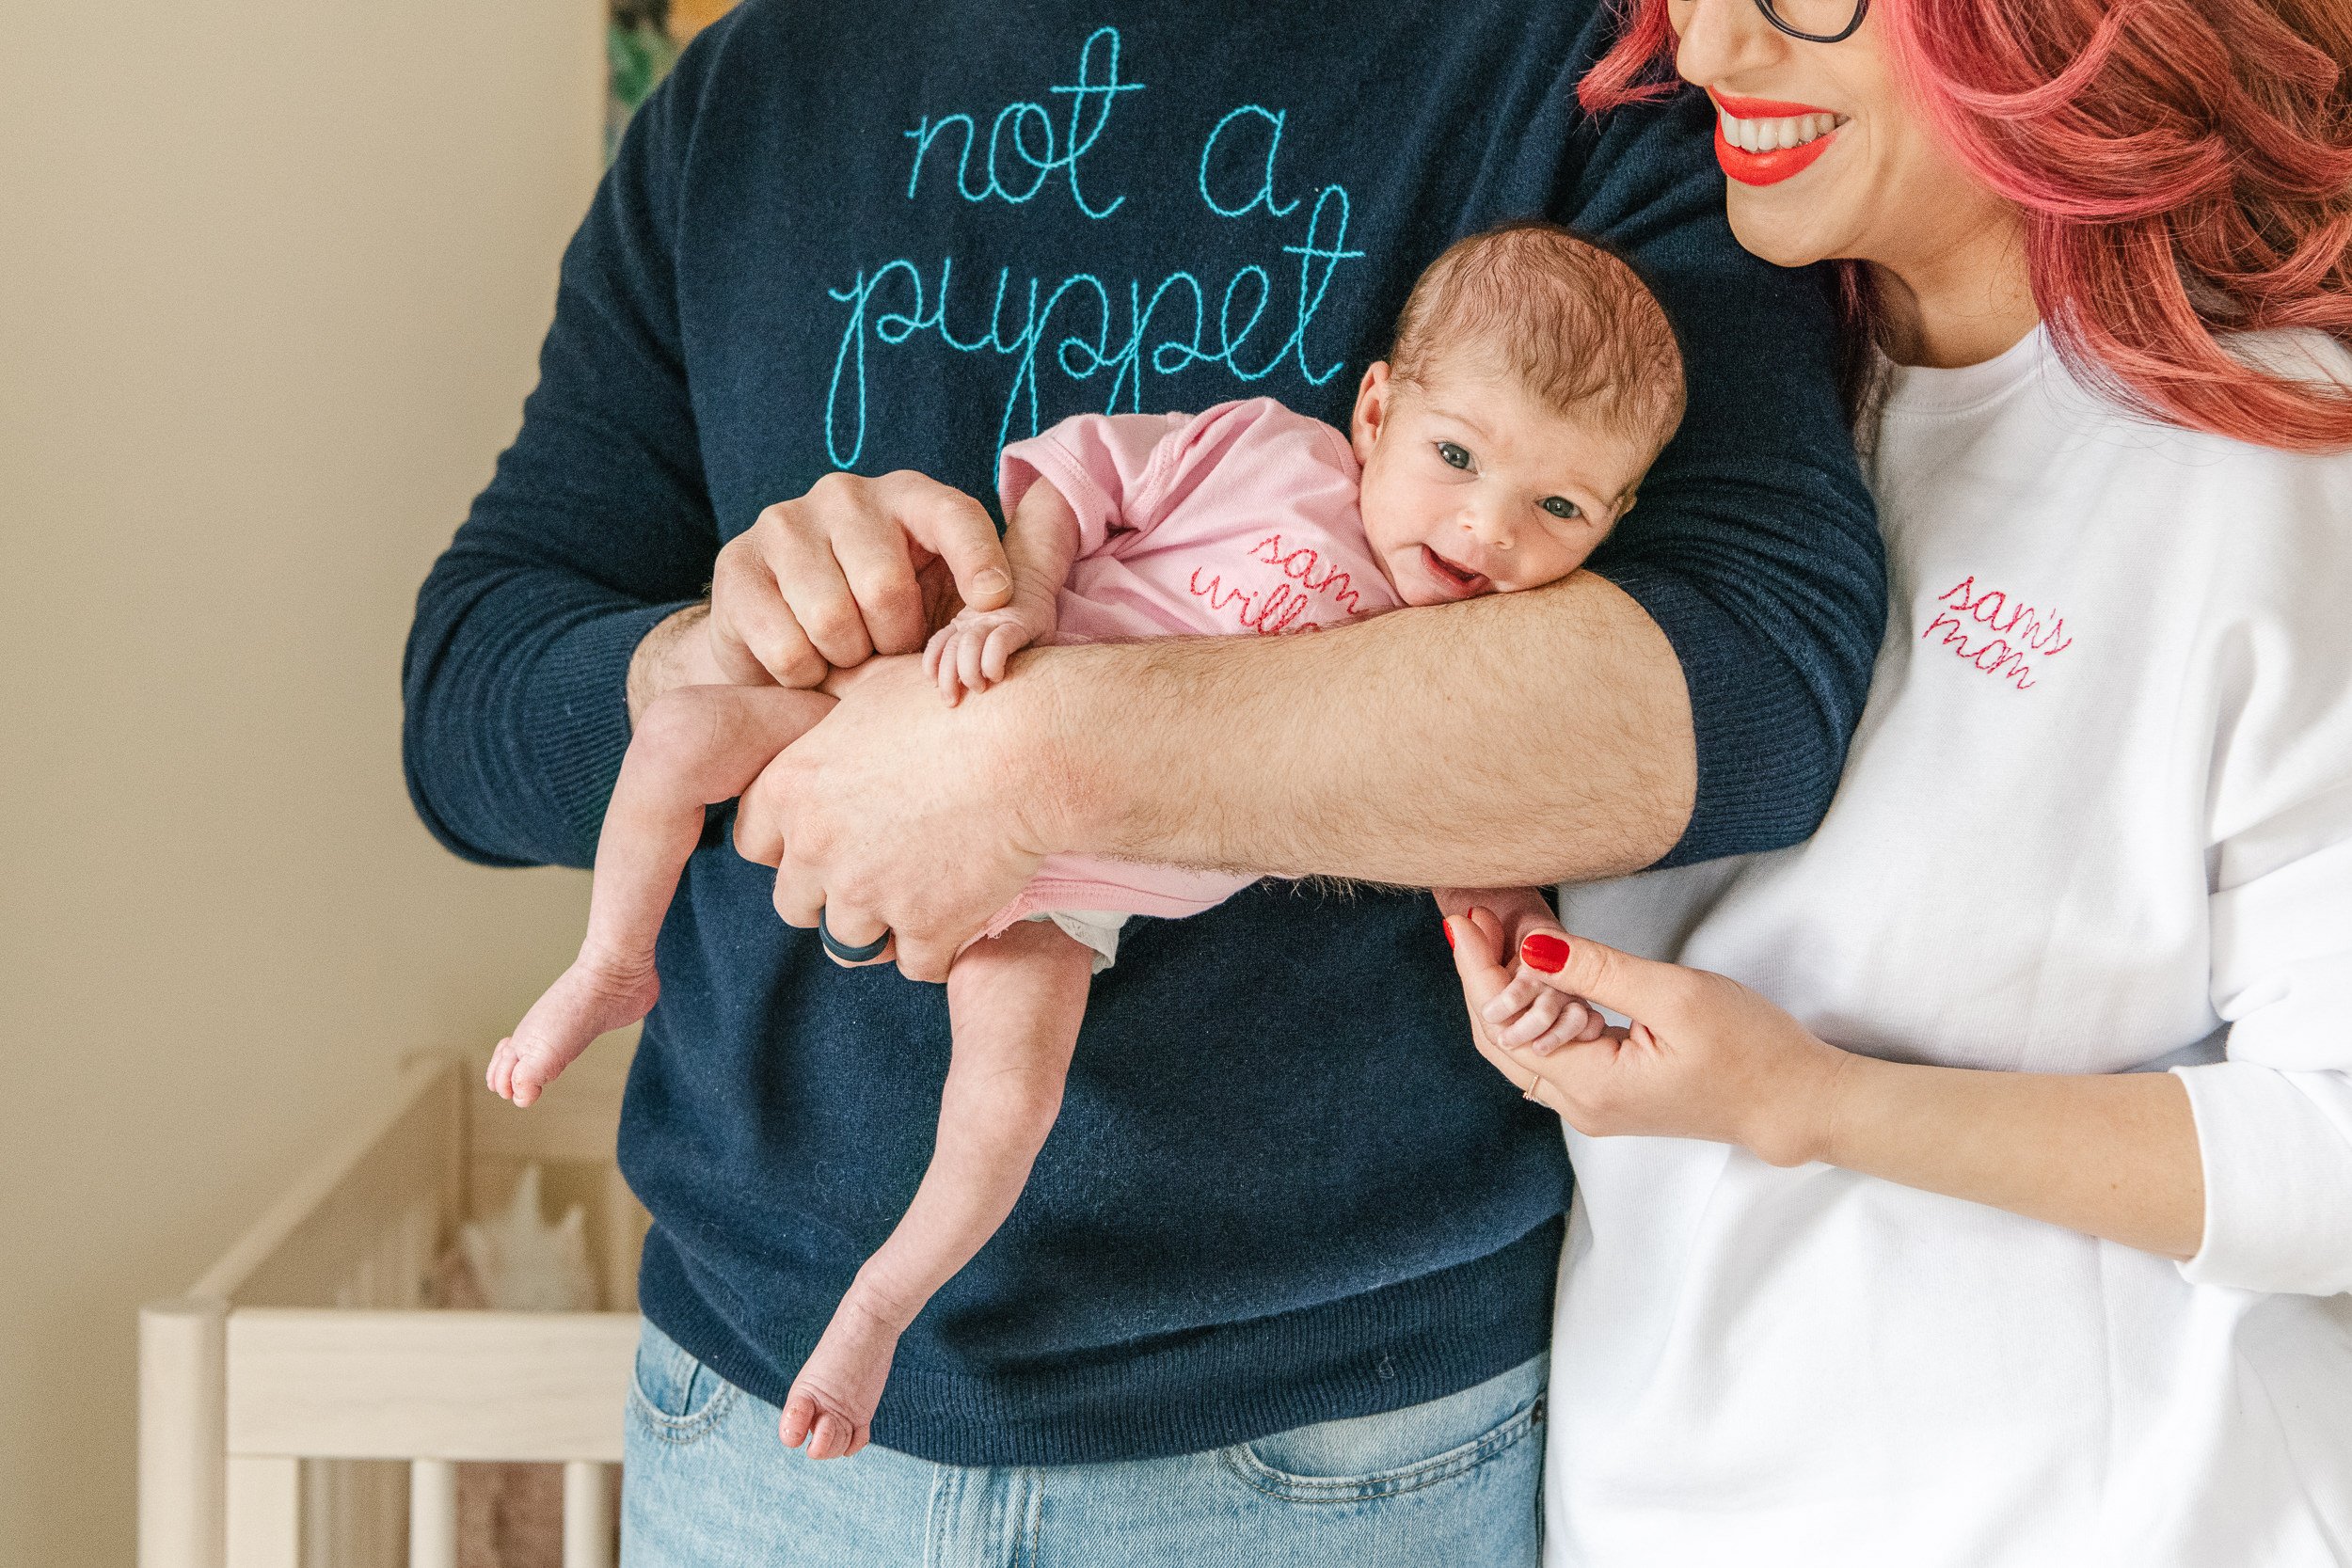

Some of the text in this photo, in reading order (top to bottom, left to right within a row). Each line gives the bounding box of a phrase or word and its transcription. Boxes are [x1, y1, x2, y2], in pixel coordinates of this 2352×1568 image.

[903, 26, 1301, 218] not a
[824, 183, 1366, 490] puppet
[1247, 534, 1371, 615] sam
[1922, 612, 2036, 689] mom
[1938, 576, 2073, 656] sam's
